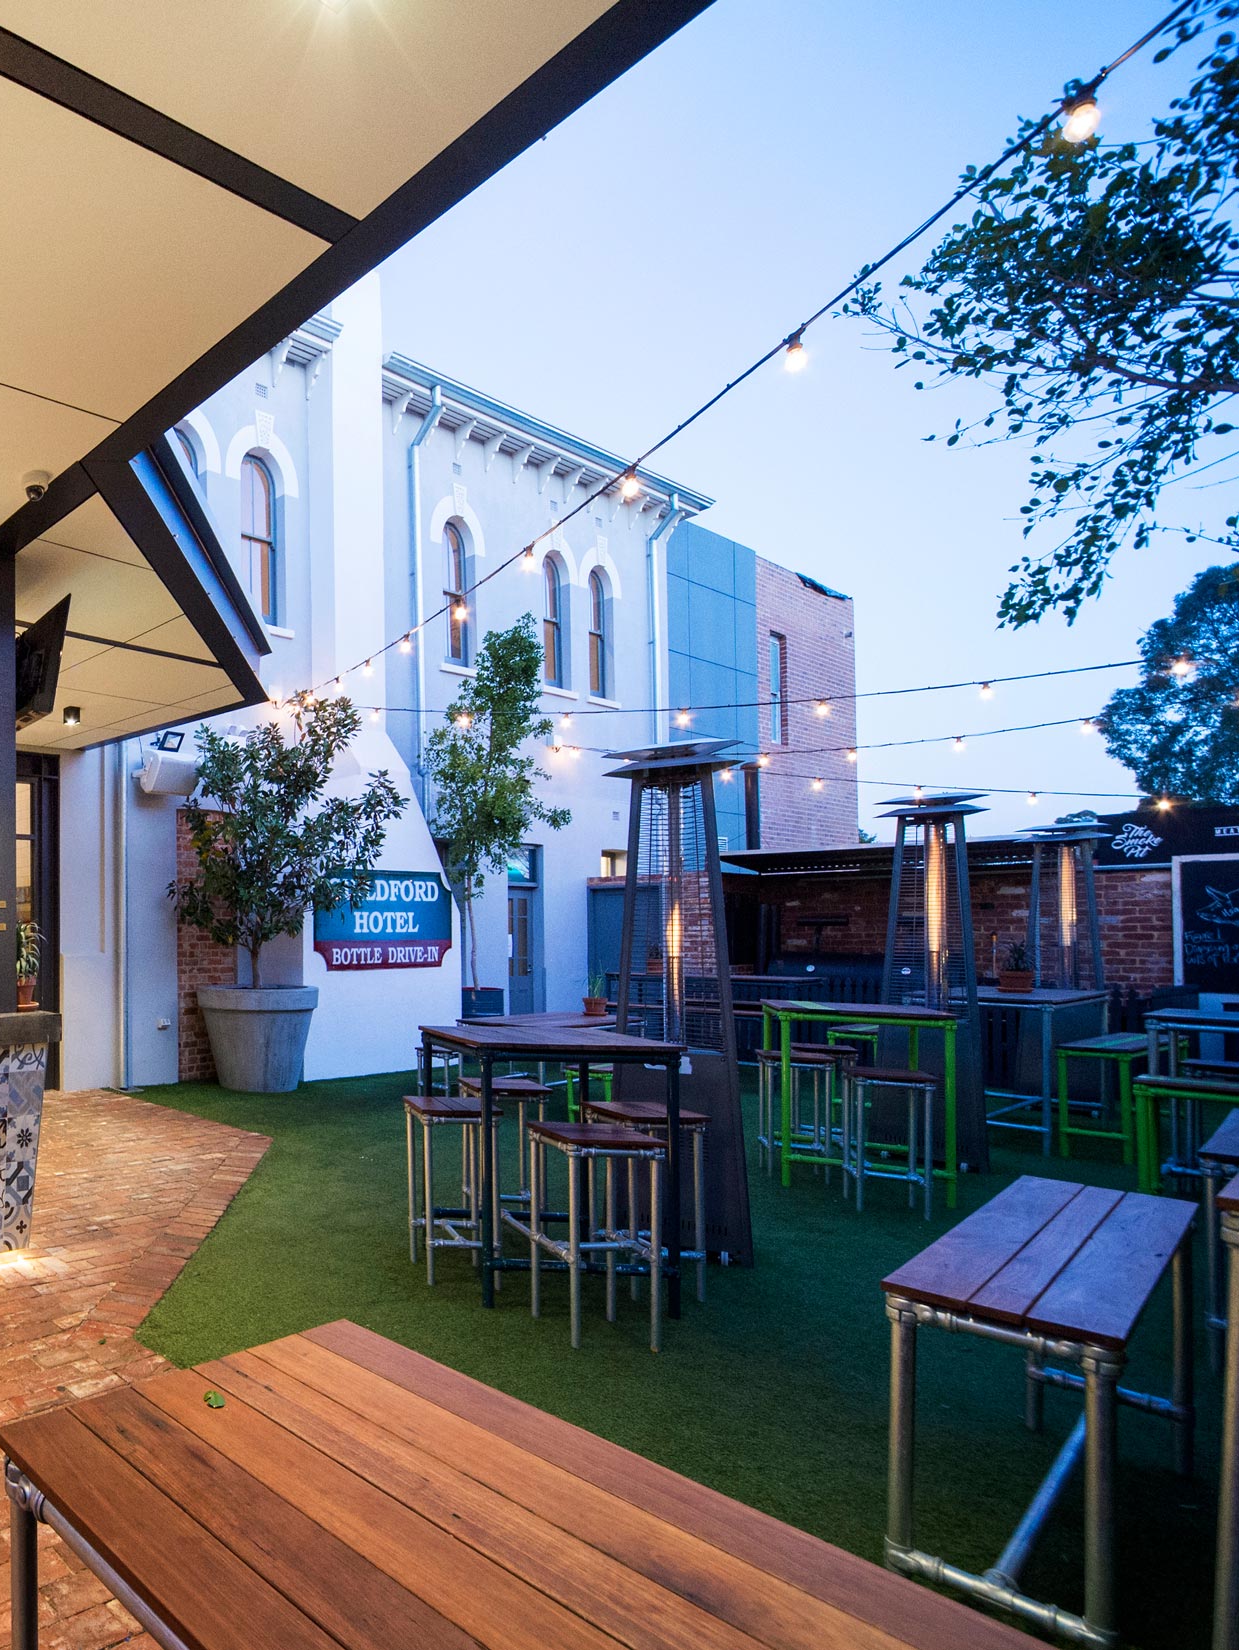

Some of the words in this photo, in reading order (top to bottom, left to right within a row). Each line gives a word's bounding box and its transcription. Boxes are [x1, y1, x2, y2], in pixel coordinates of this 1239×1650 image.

[1122, 823, 1153, 838] The
[1111, 833, 1163, 850] Smoke
[1123, 845, 1152, 858] Pit
[353, 911, 419, 933] HOTEL
[332, 948, 382, 965] BOTTLE
[388, 946, 439, 963] DRIVE-IN
